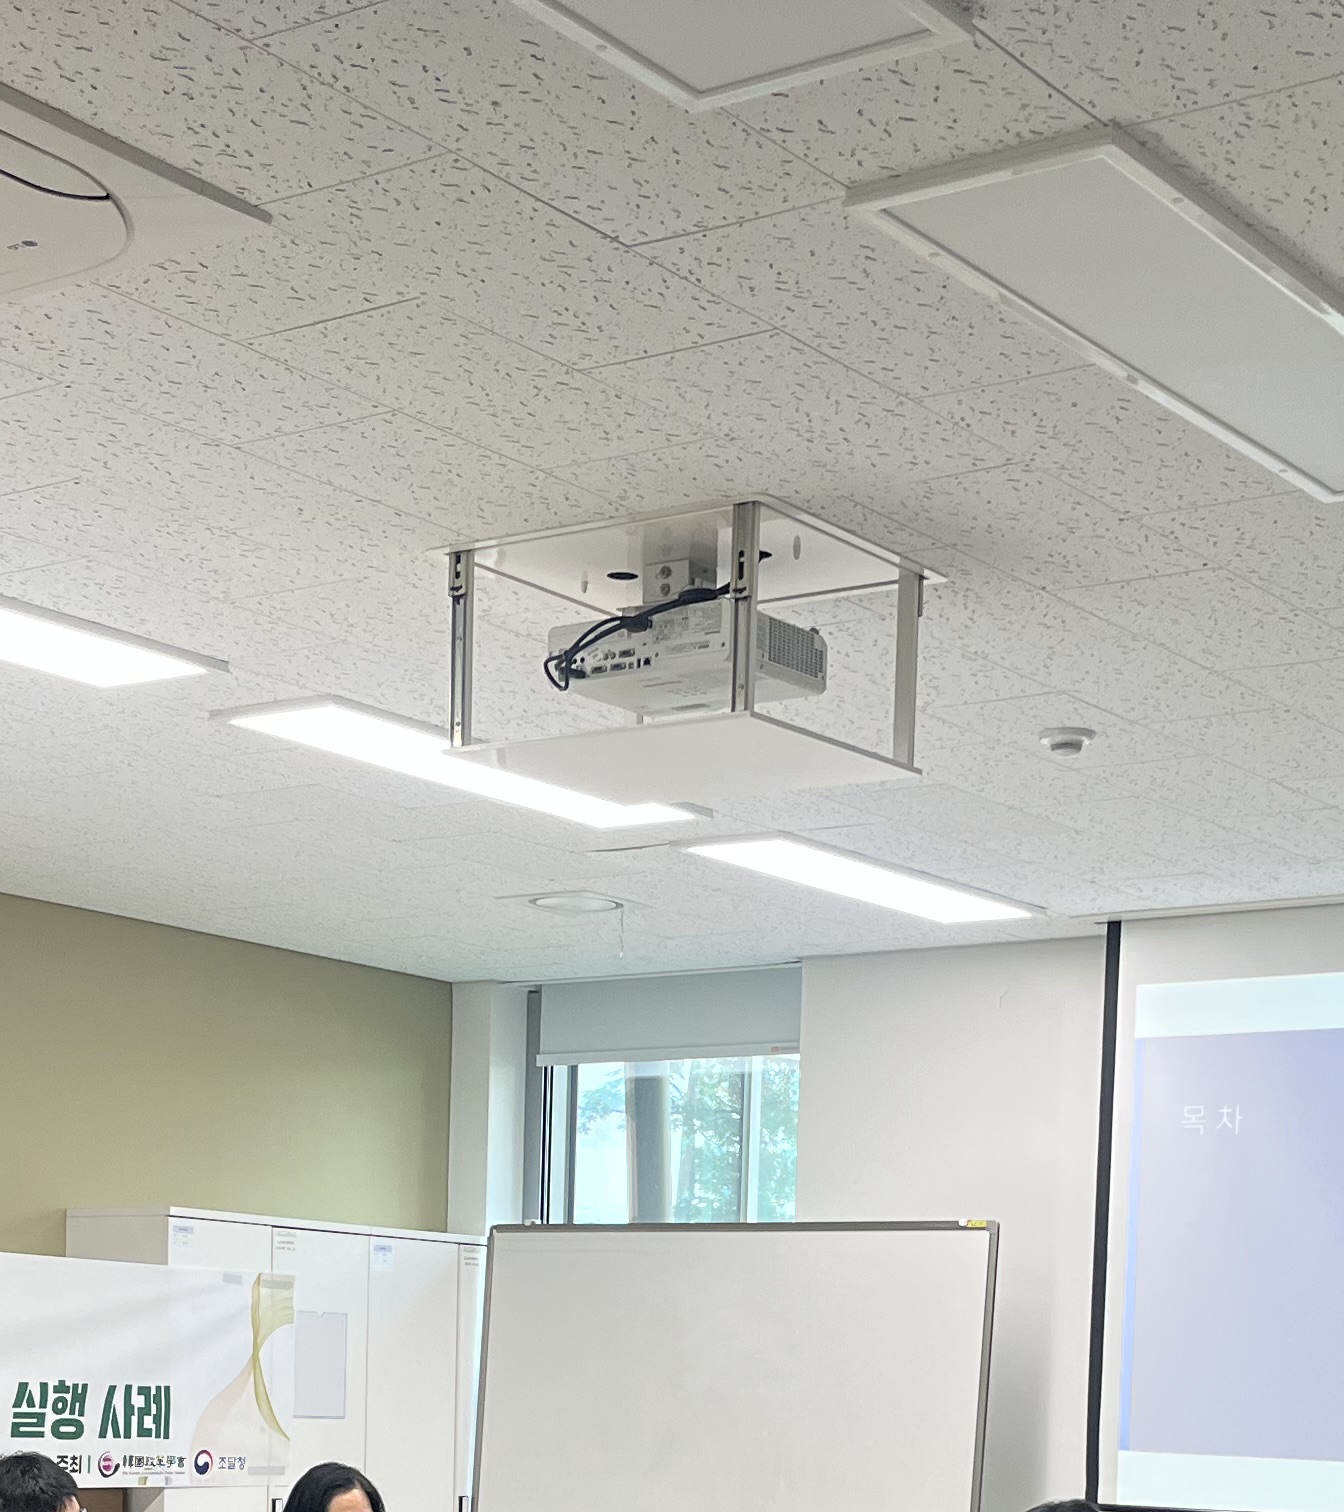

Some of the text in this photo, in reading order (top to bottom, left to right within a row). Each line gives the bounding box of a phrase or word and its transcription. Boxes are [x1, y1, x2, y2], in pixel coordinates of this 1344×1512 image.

[11, 1380, 88, 1440] 실행
[98, 1384, 170, 1439] 사례
[57, 1455, 82, 1474] 주최
[218, 1456, 247, 1470] 조달청
